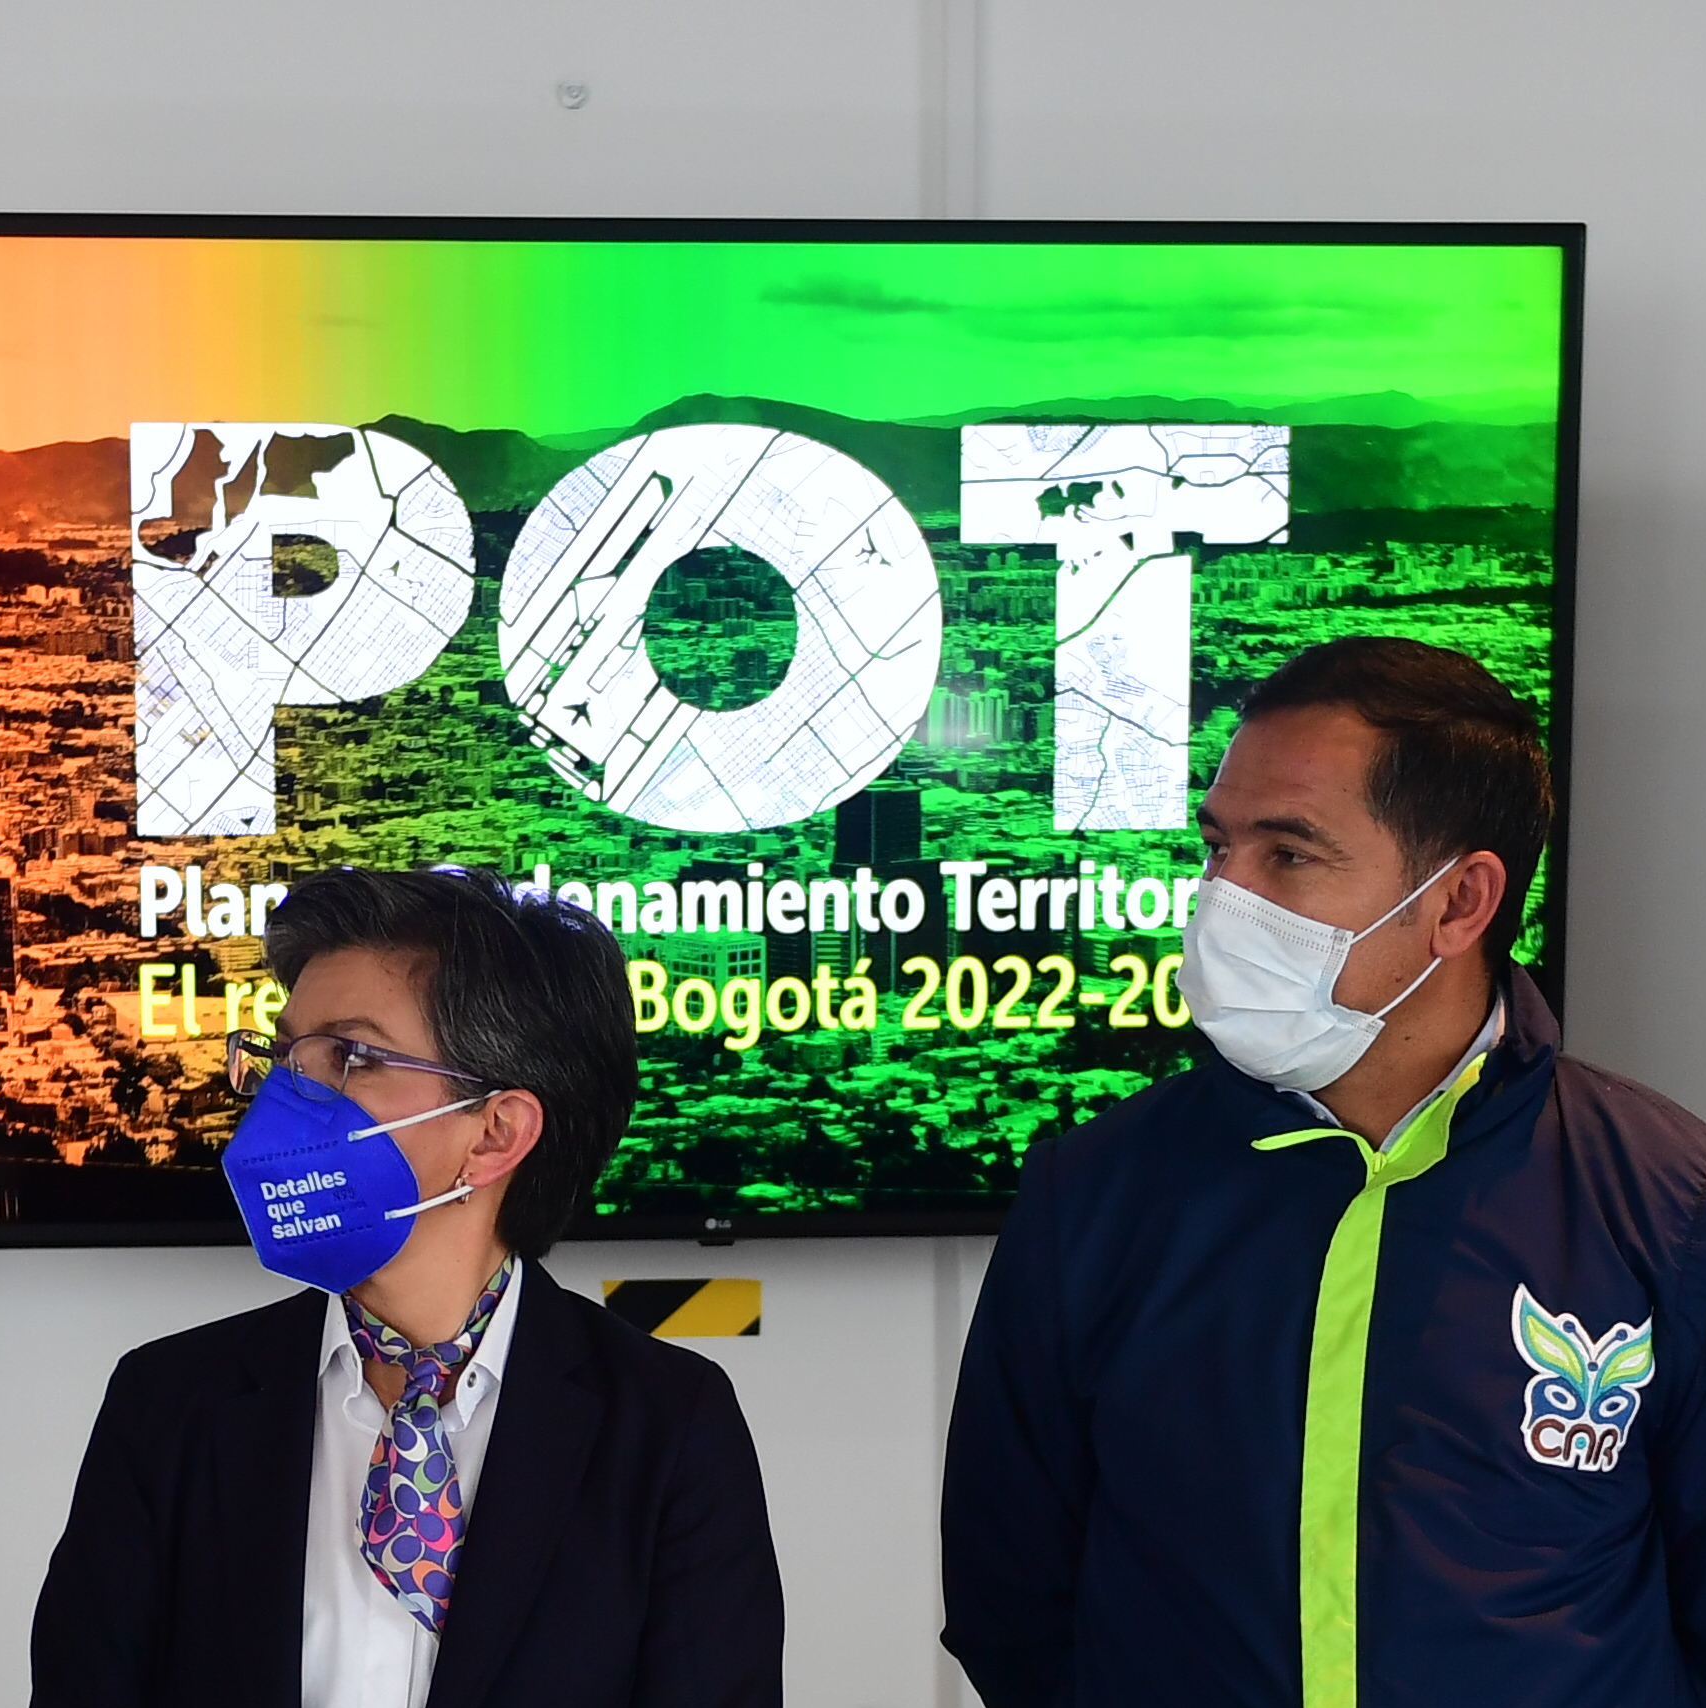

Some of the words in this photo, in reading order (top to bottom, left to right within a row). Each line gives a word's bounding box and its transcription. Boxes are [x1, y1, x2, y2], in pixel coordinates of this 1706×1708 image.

[131, 421, 1291, 837] POT
[138, 963, 202, 1036] El
[630, 958, 877, 1050] Bogotá
[260, 1171, 346, 1200] Detalles
[267, 1200, 306, 1222] que
[271, 1212, 342, 1240] salvan
[1531, 1418, 1619, 1466] CAR
